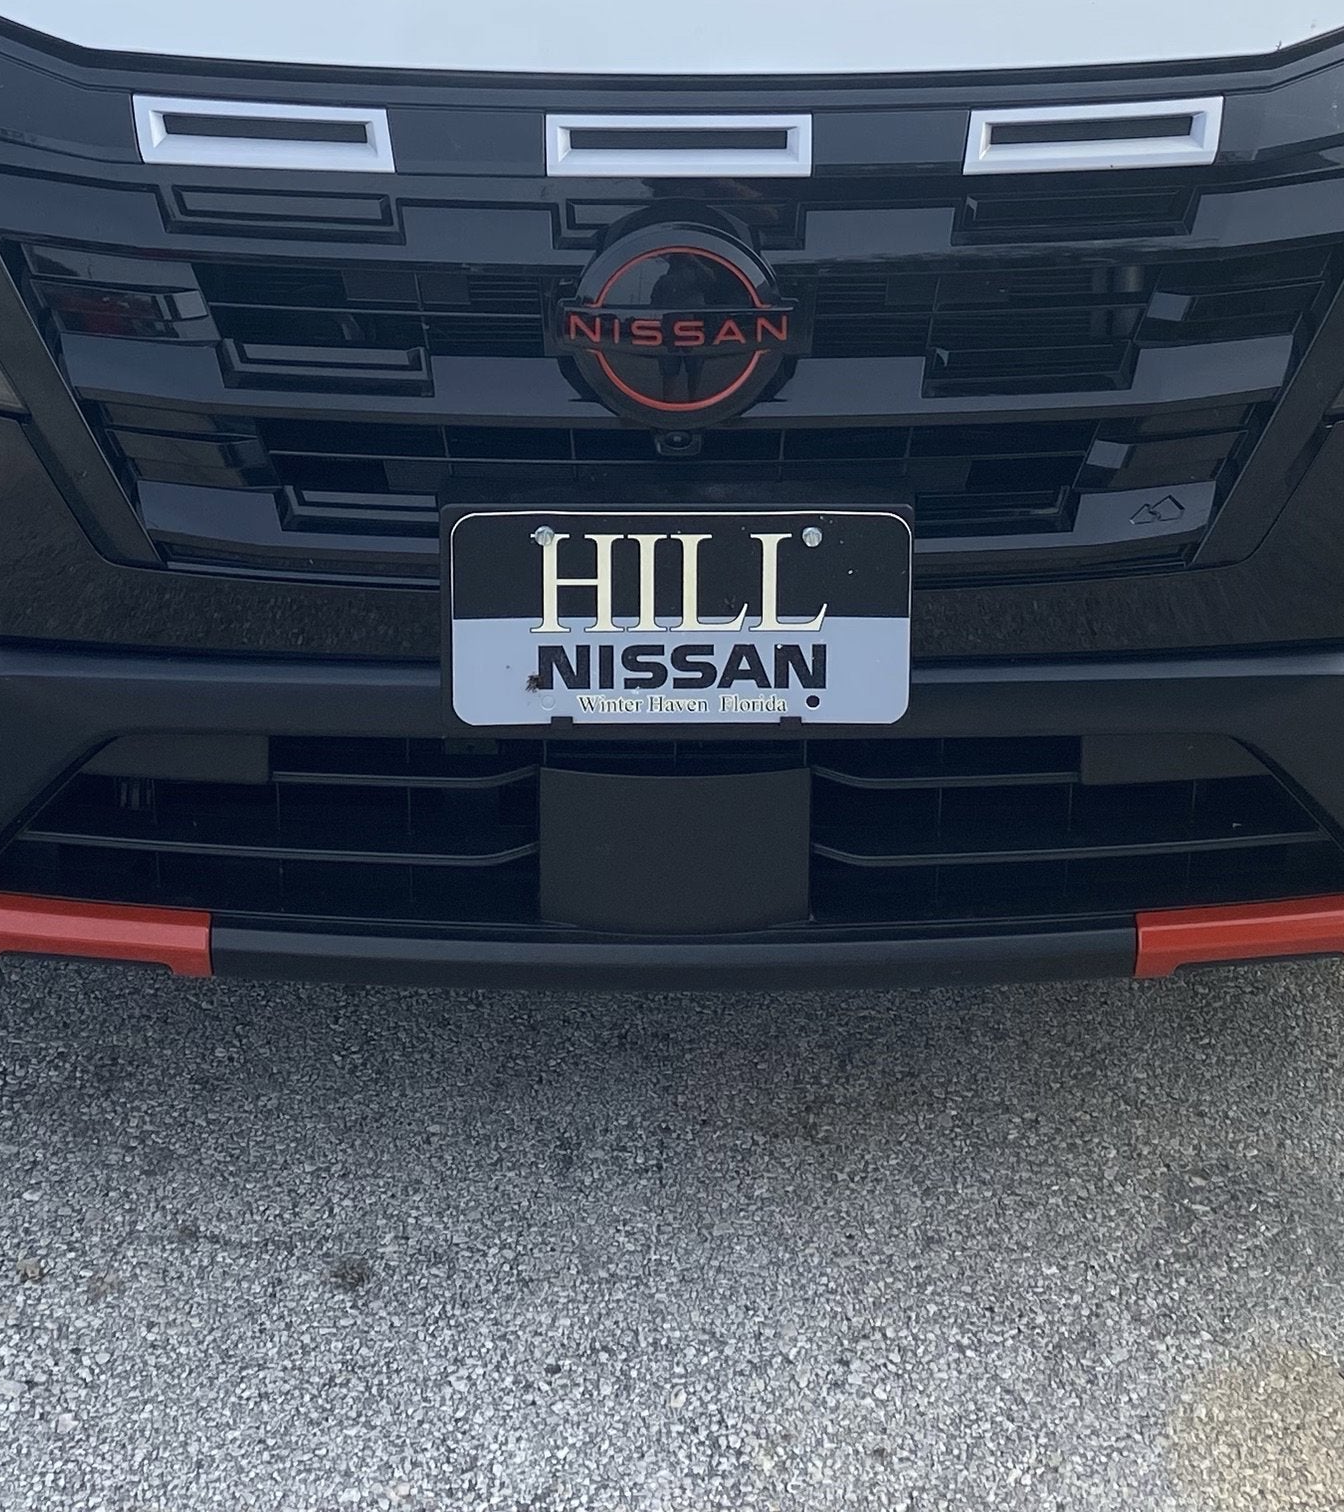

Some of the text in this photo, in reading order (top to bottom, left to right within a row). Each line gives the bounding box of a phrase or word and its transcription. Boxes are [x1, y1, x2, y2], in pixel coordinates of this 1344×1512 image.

[567, 313, 788, 347] NISSAN
[529, 532, 828, 633] HILL
[537, 643, 827, 690] NISSAN
[577, 694, 787, 713] Winter Haven Florida
